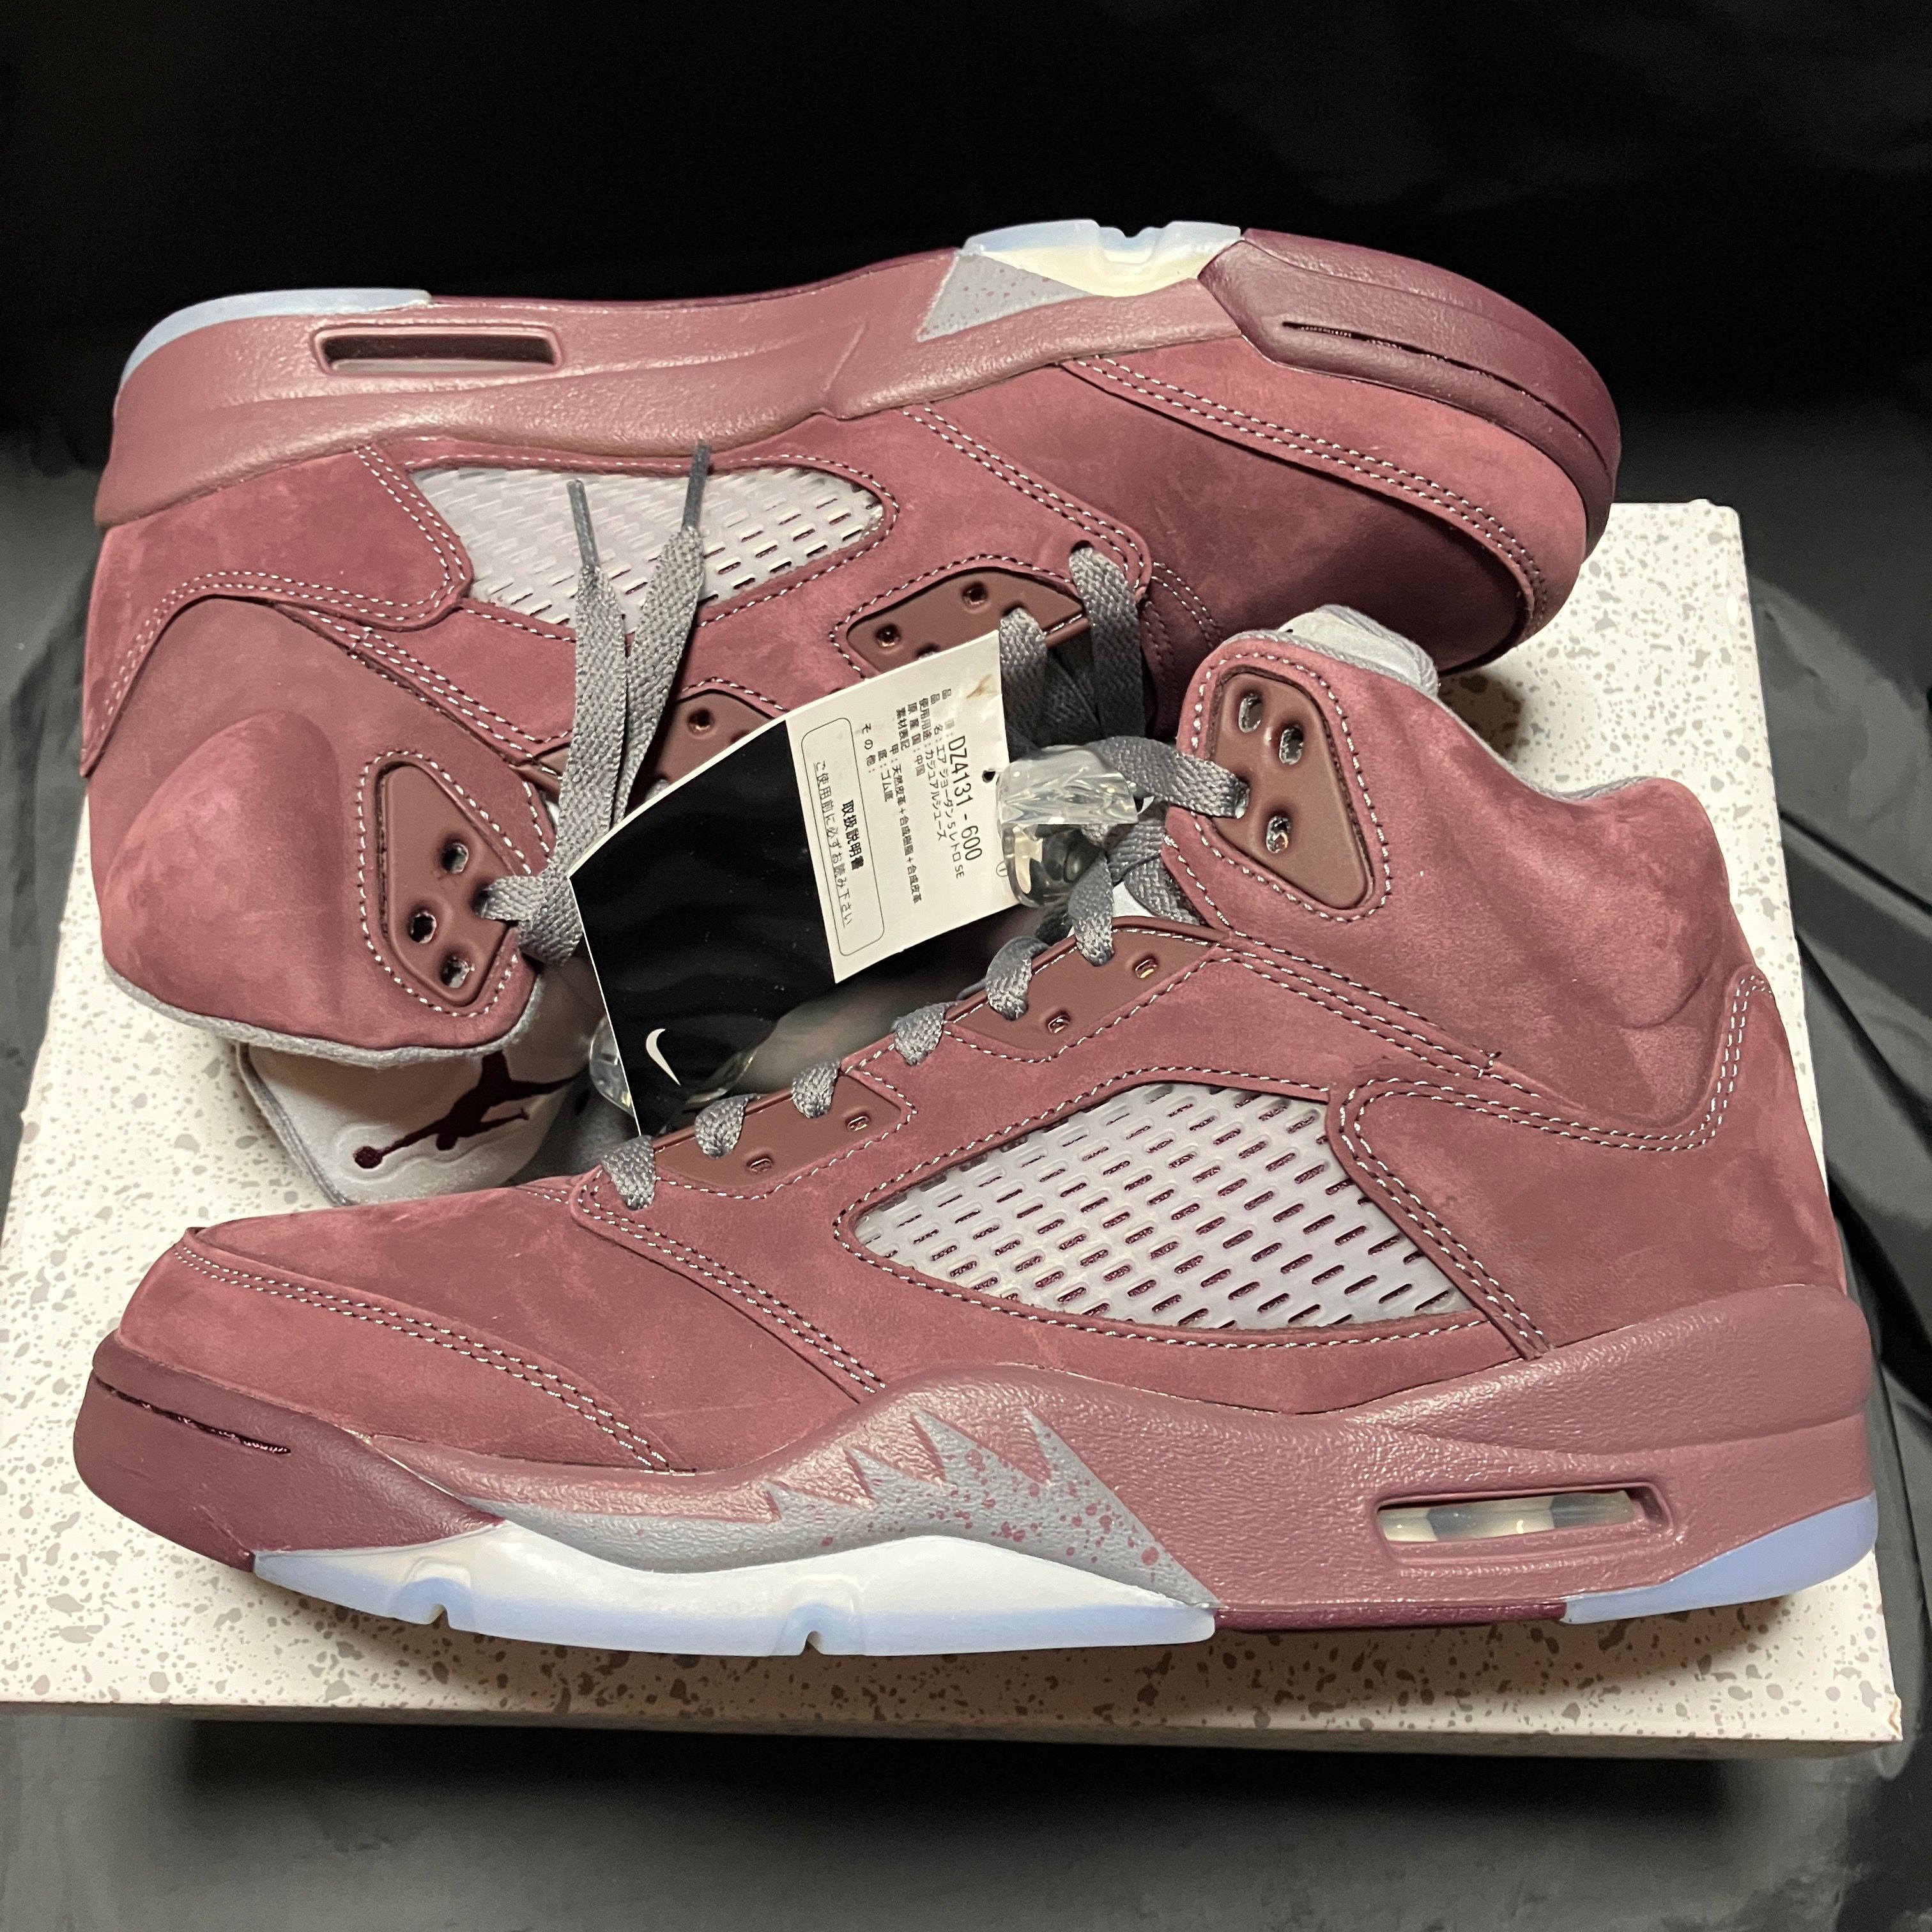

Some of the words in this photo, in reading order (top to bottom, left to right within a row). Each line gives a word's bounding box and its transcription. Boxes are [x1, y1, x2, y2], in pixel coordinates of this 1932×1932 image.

[936, 744, 947, 763] エア
[939, 768, 954, 818] ジョーダン
[948, 735, 974, 806] DZ4131
[961, 825, 983, 861] 600
[949, 831, 962, 862] レトロ
[954, 864, 965, 879] SE
